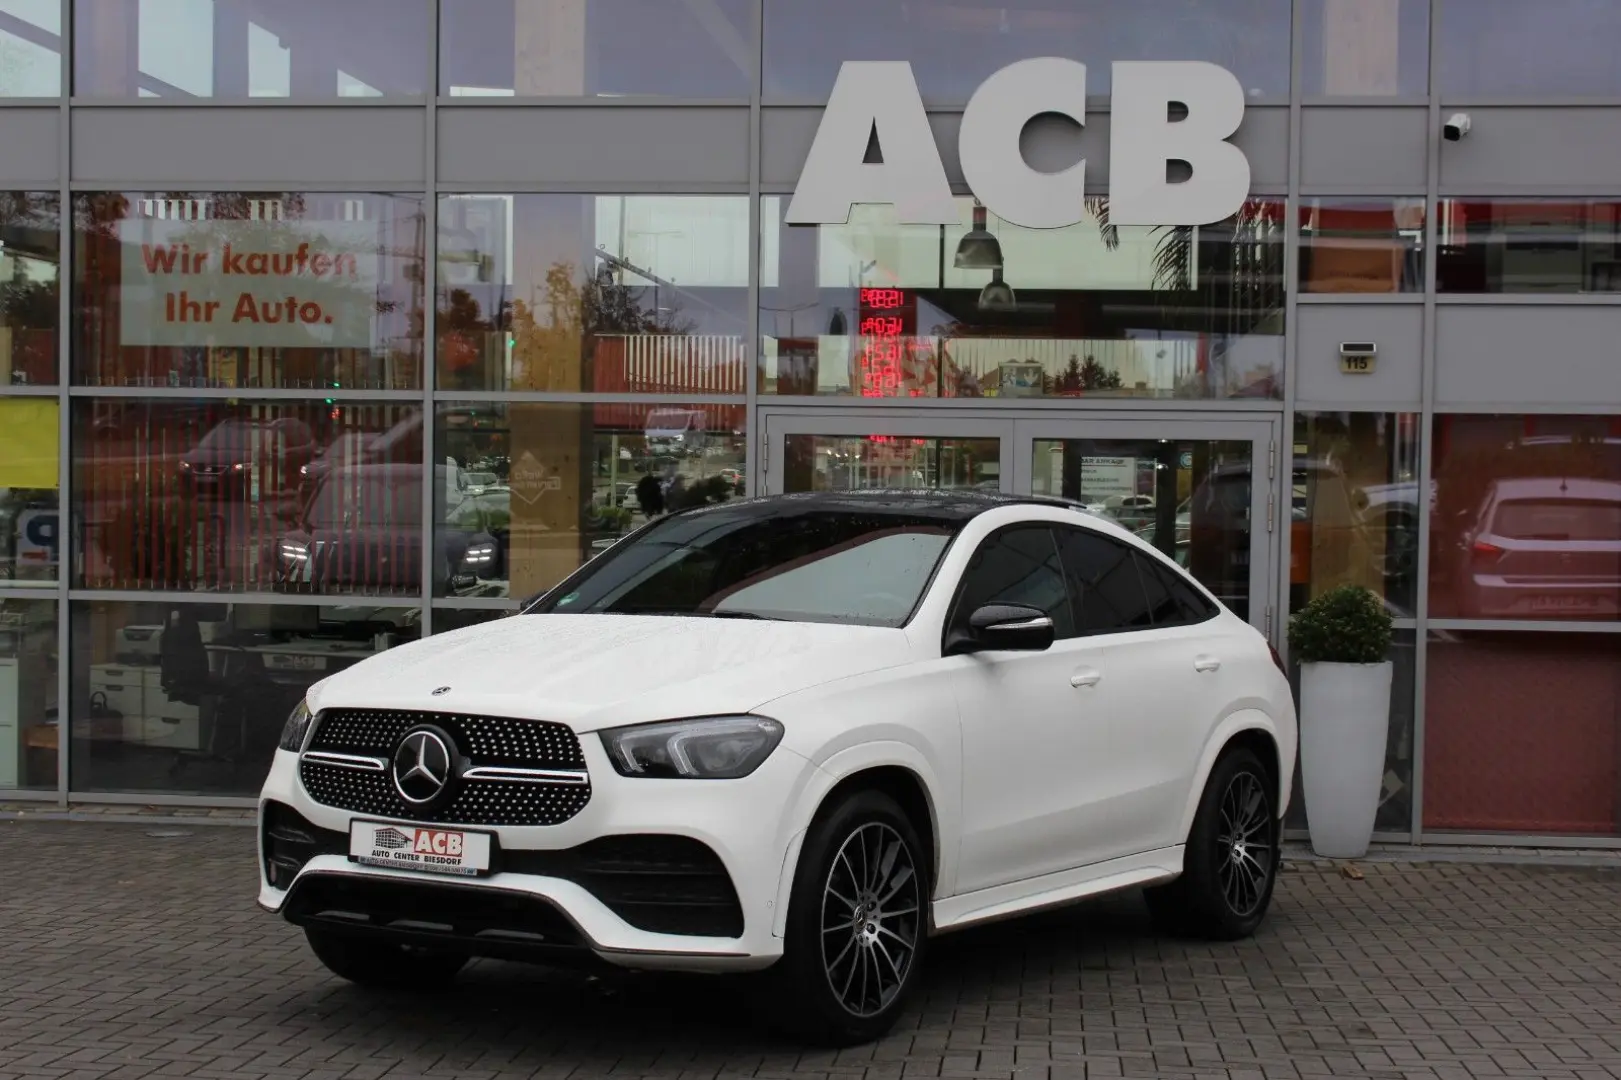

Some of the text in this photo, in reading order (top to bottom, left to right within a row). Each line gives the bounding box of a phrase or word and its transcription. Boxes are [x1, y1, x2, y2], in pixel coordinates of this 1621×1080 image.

[786, 57, 1251, 228] ACB
[141, 241, 358, 277] Wir kaufen
[165, 291, 334, 325] Ihr Auto.
[1345, 356, 1368, 370] 115
[415, 831, 462, 856] ACB
[394, 852, 420, 861] CENTER
[424, 856, 462, 865] BIESDORF
